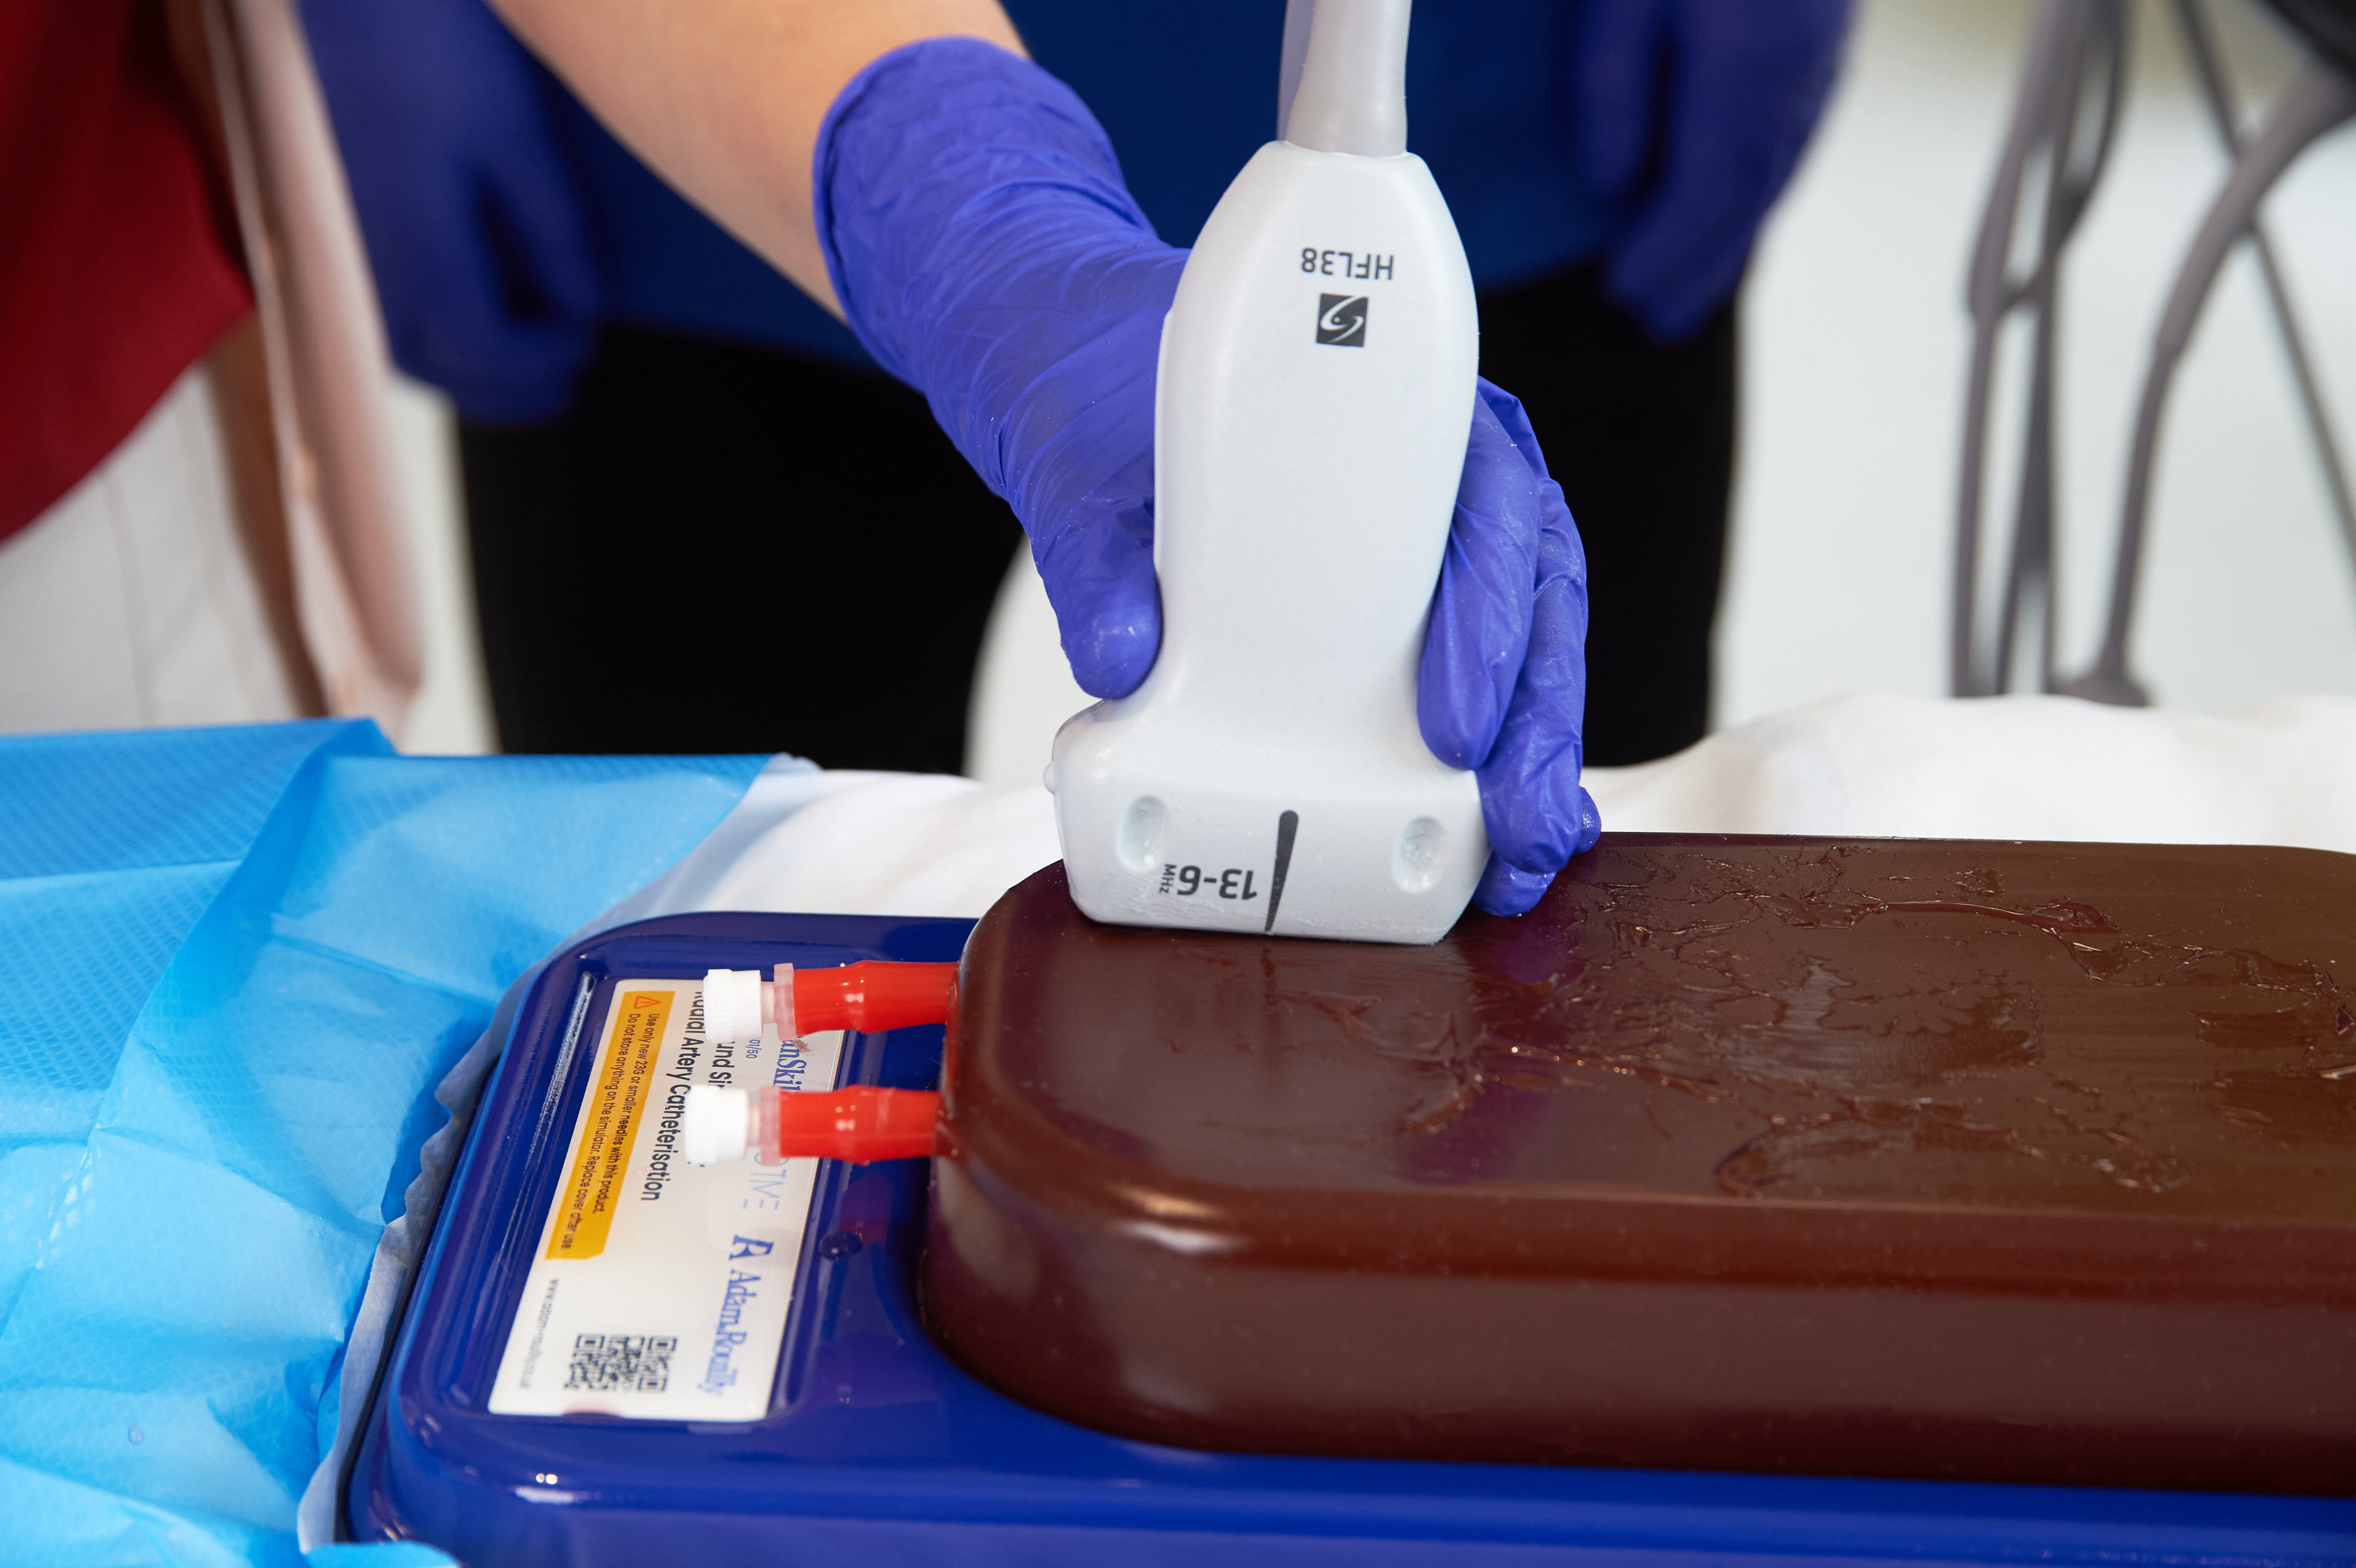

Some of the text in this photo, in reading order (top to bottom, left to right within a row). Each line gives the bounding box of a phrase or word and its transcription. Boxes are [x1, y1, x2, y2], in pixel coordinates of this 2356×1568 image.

[1301, 247, 1394, 280] HFL38
[1159, 863, 1177, 893] MHz
[1177, 865, 1257, 900] 13-6
[628, 1013, 641, 1024] Do
[646, 1013, 661, 1026] Use
[623, 1024, 637, 1036] not
[638, 1028, 654, 1043] only
[618, 1037, 633, 1056] store
[637, 1044, 649, 1059] new
[711, 1041, 735, 1068] und
[745, 1038, 762, 1058] 01/50
[633, 1060, 648, 1075] 23G
[665, 1037, 704, 1081] Artery
[604, 1057, 627, 1089] anything
[605, 1091, 618, 1101] on
[622, 1086, 638, 1113] smaller
[601, 1102, 616, 1115] the
[589, 1116, 611, 1154] simulator.
[613, 1115, 630, 1145] needles
[641, 1084, 691, 1200] Catheterisation
[608, 1146, 623, 1163] with
[579, 1156, 600, 1187] Replace
[603, 1165, 619, 1179] this
[573, 1188, 589, 1211] cover
[592, 1180, 612, 1214] product.
[566, 1212, 583, 1232] after
